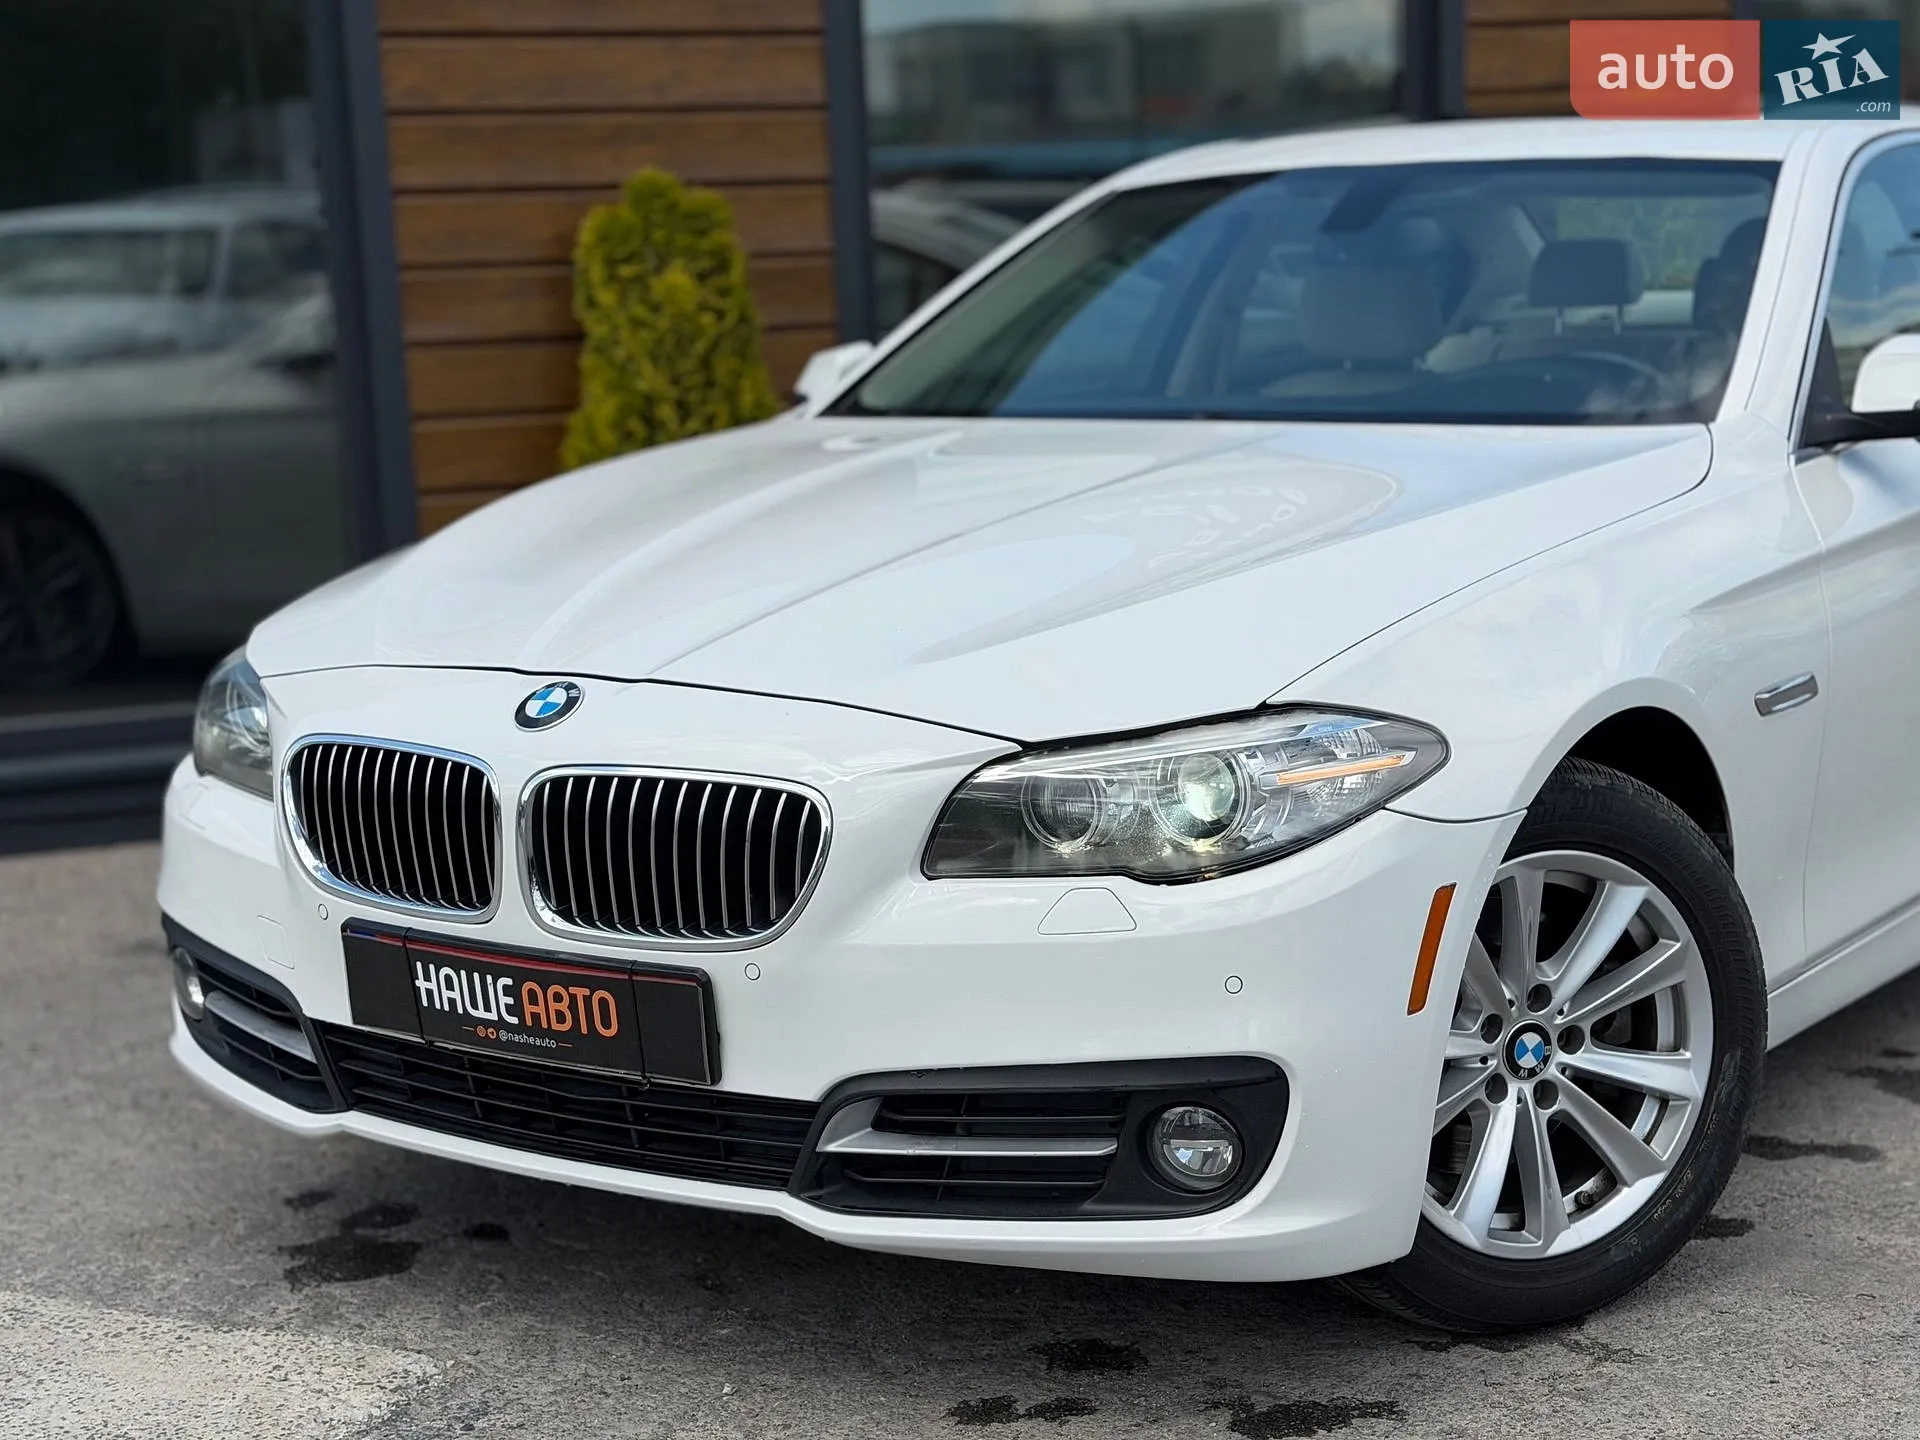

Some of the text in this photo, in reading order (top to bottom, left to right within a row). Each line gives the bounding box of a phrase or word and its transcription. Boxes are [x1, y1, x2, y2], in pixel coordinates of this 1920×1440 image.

[415, 961, 618, 1037] НАШЕ АВТО
[498, 1029, 557, 1048] @nasheauto
